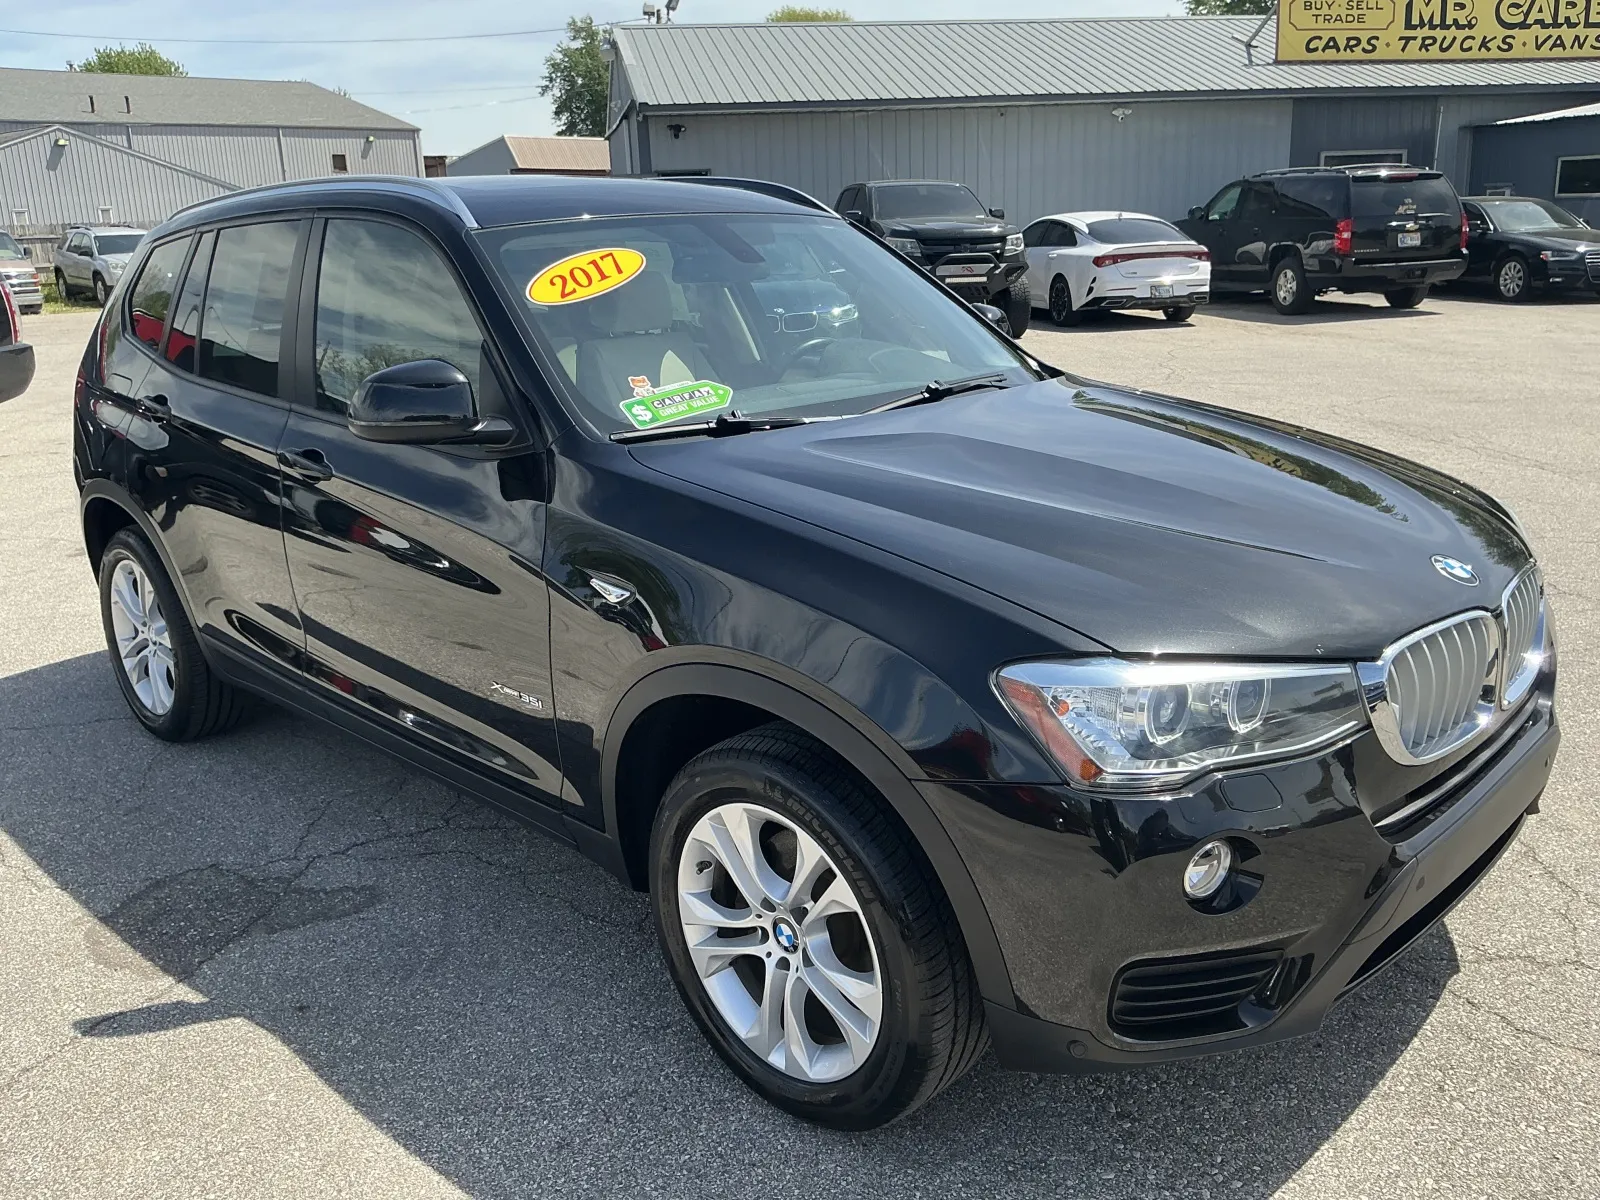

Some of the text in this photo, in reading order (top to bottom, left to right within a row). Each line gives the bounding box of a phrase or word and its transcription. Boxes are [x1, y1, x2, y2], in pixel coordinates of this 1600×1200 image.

[1303, 0, 1384, 11] BUY SELL
[1404, 0, 1478, 31] MR.
[1311, 13, 1367, 24] TRADE
[1304, 35, 1380, 55] CARS
[1397, 34, 1516, 54] TRUCKS
[549, 251, 624, 299] 2017
[651, 386, 714, 409] CARFAX
[659, 395, 721, 417] GREAT VALUE
